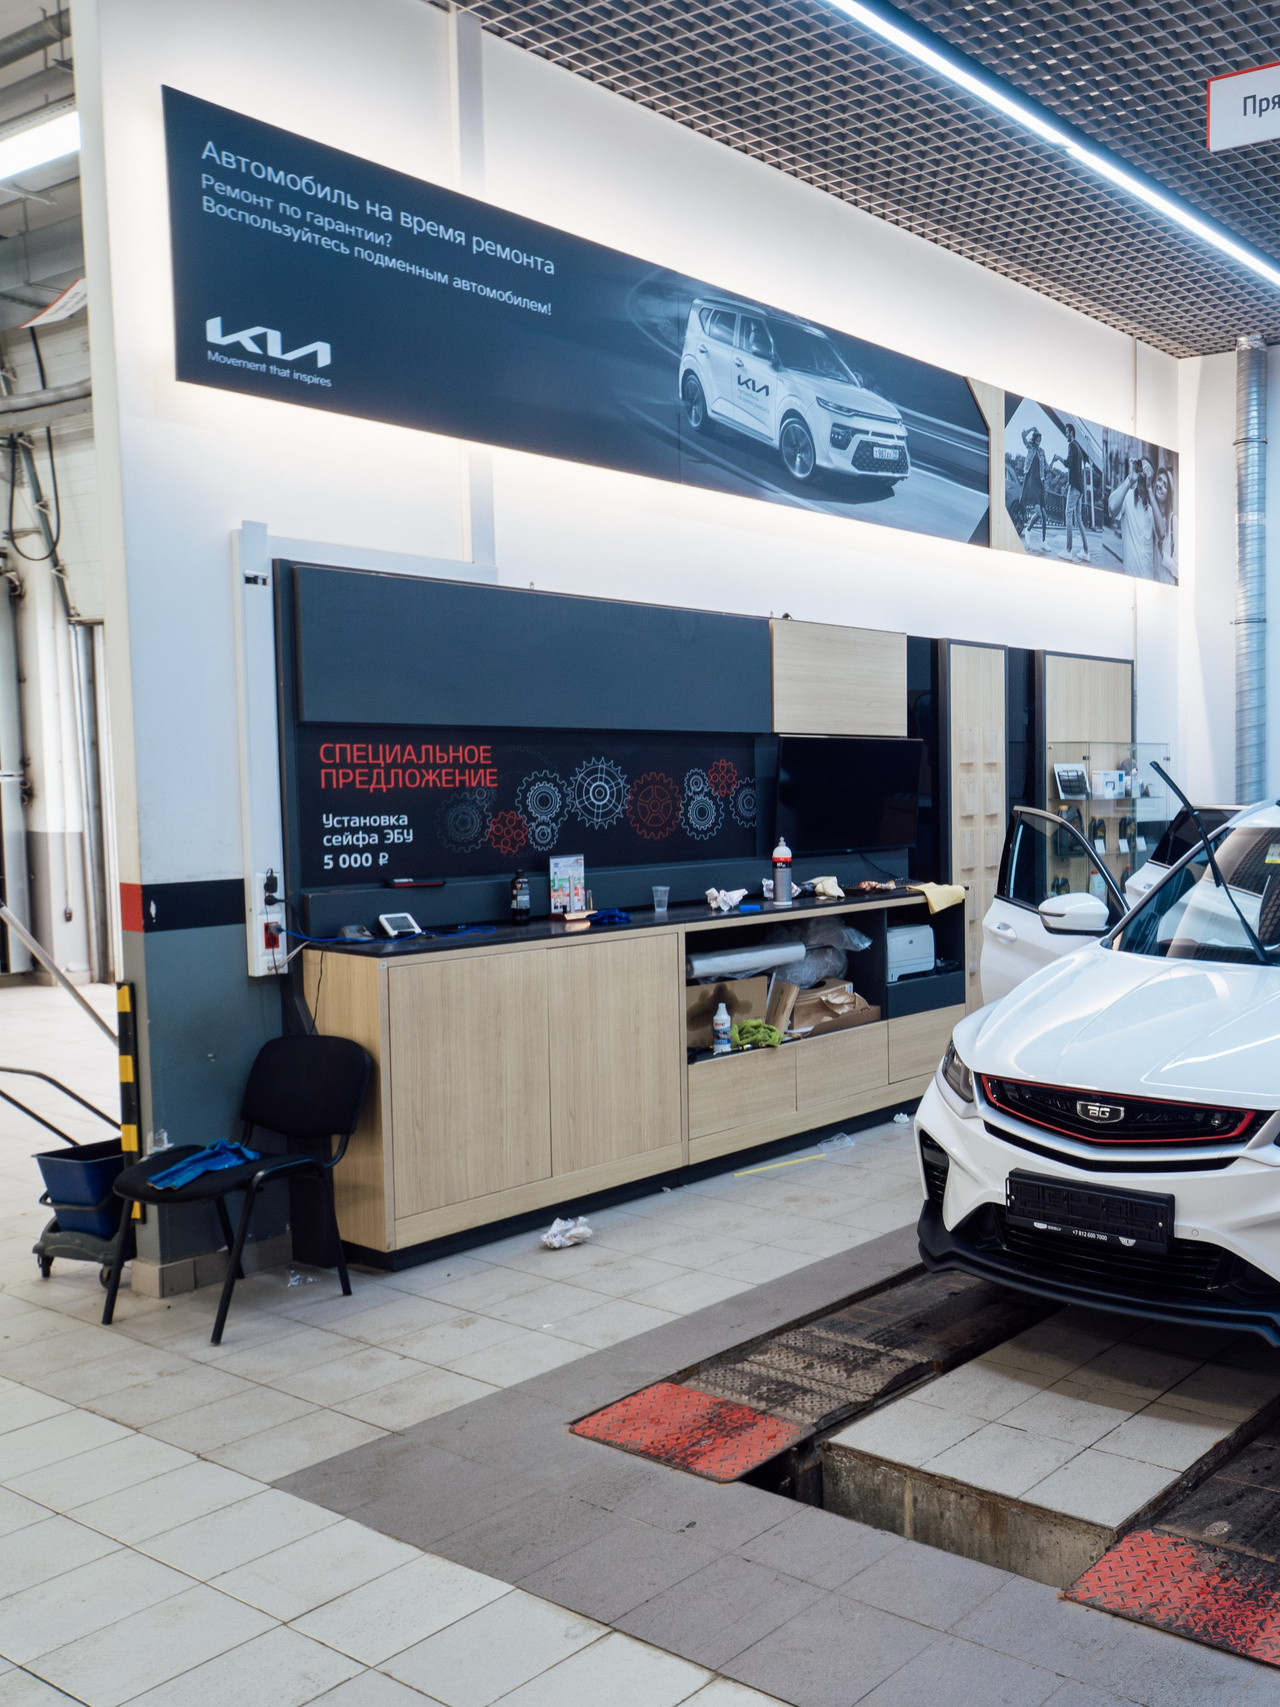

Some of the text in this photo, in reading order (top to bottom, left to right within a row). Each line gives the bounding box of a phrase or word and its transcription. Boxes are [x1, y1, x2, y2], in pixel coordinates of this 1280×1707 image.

[201, 141, 555, 275] Автомобиль на время ремонта
[202, 173, 392, 247] Ремонт по гарантии?
[202, 195, 552, 316] Воспользуйтесь подменным автомобилем!
[206, 316, 332, 368] KIA
[207, 350, 332, 387] Movement that inspires
[737, 373, 770, 397] KIA
[319, 743, 493, 768] СПЕЦИАЛЬНОЕ
[320, 768, 498, 793] ПРЕДЛОЖЕНИЕ
[322, 813, 409, 829] Установка
[323, 828, 414, 848] сейфа ЭБУ
[323, 854, 334, 870] 5
[338, 853, 373, 869] 000
[1087, 1231, 1096, 1239] 600
[1096, 1233, 1108, 1241] 7000
